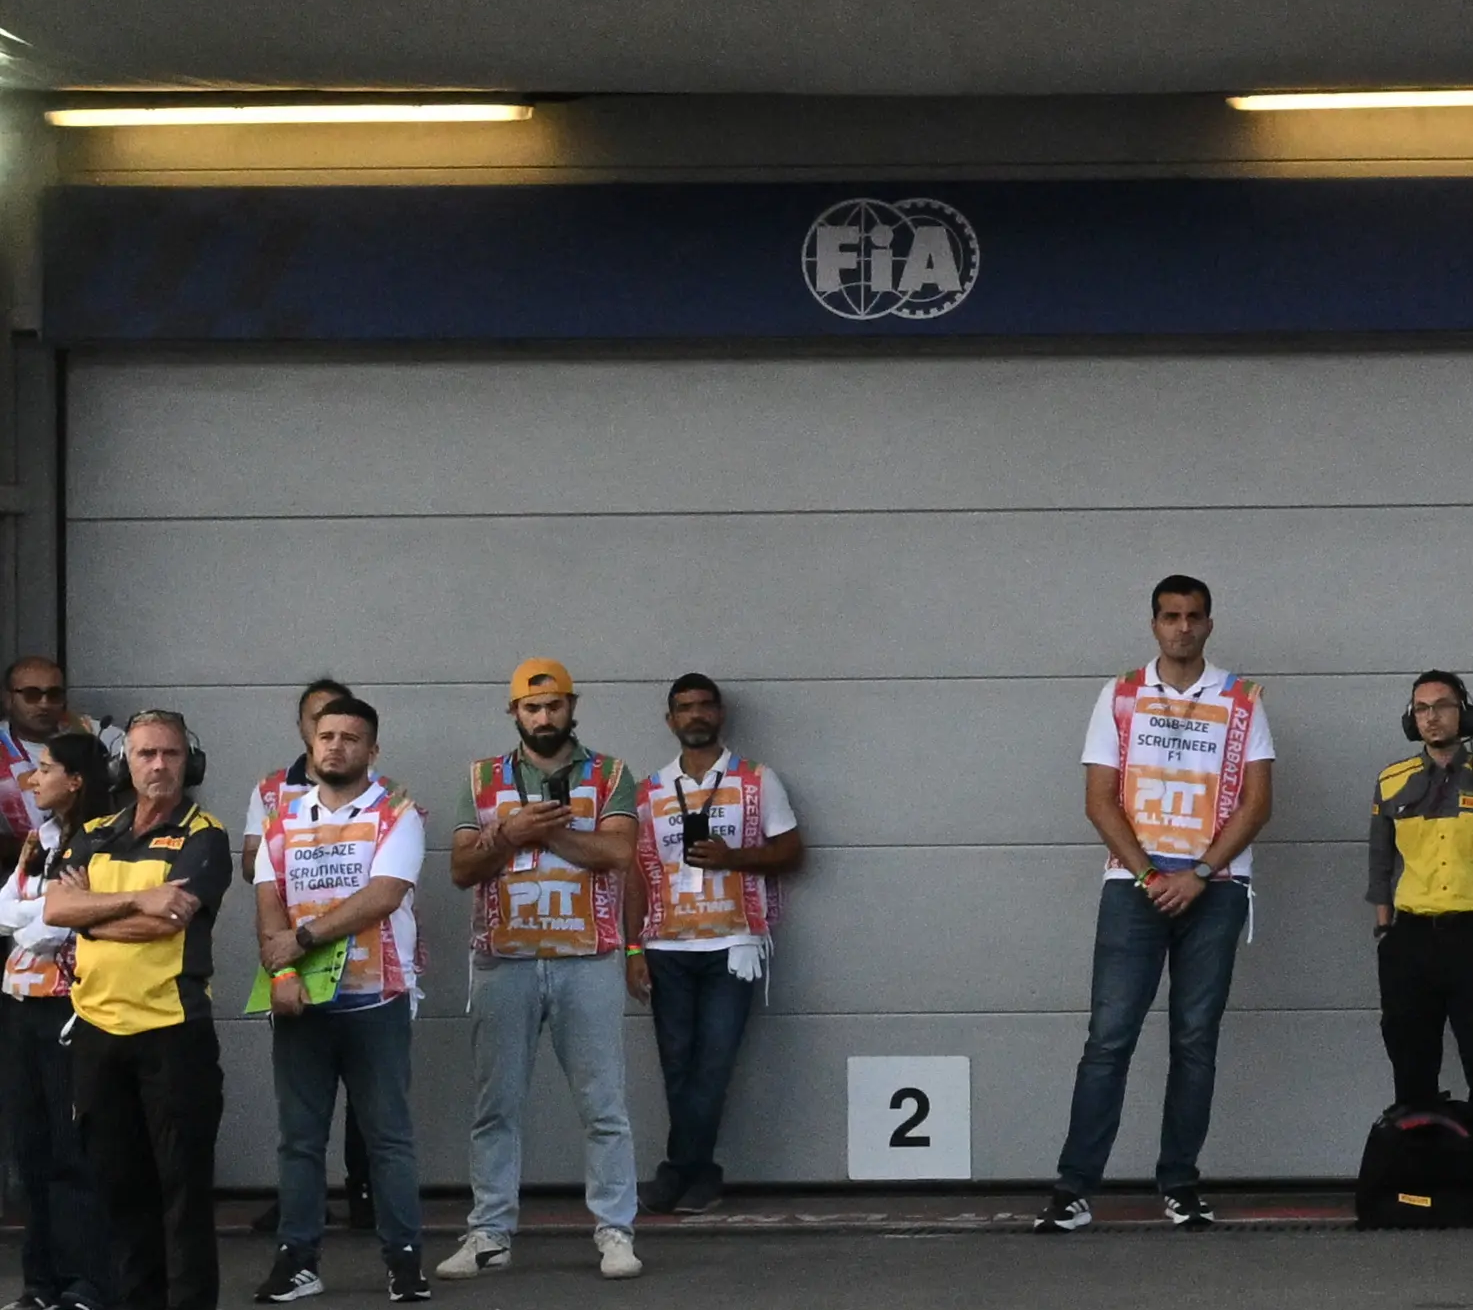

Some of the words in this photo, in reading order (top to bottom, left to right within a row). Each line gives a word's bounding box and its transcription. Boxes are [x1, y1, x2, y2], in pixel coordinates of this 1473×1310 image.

[1137, 734, 1218, 754] SCRUTINEER
[289, 863, 363, 881] SCRUTINEER
[507, 880, 581, 917] PIT
[889, 1087, 931, 1148] 2
